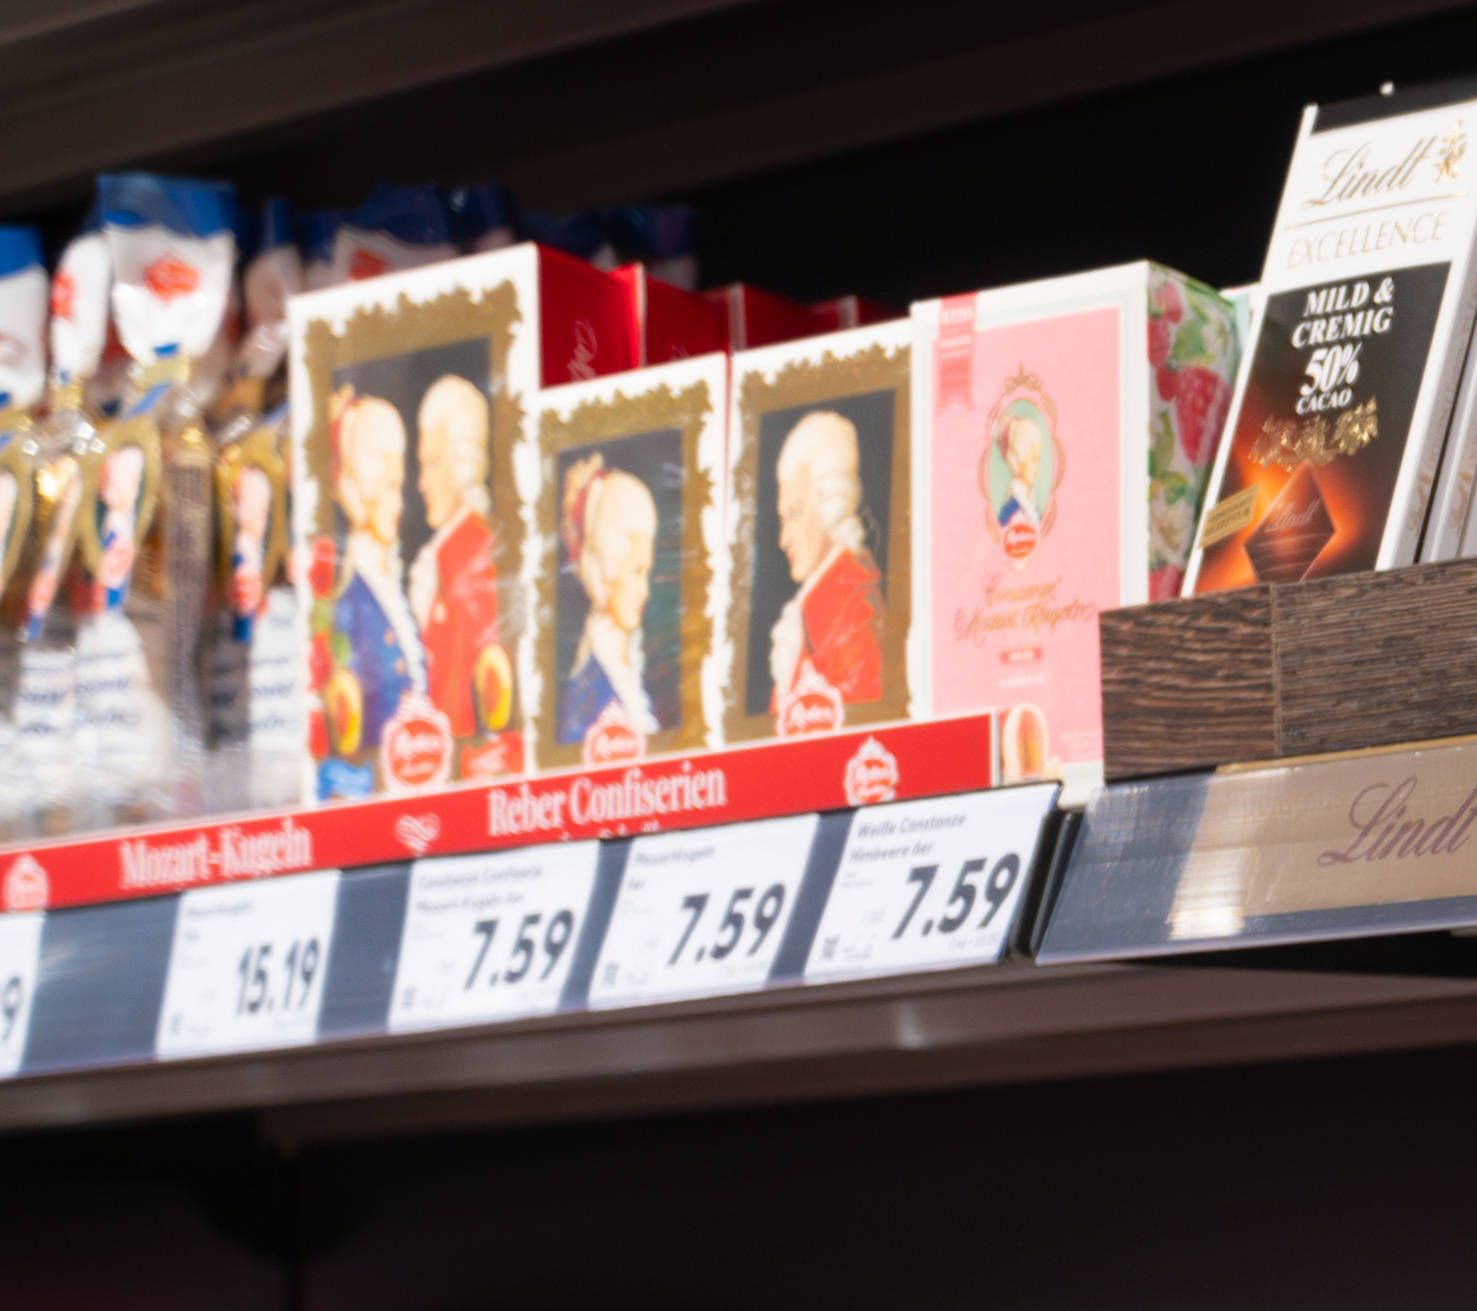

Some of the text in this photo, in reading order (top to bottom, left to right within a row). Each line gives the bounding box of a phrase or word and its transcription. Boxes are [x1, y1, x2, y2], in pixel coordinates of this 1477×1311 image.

[1285, 211, 1445, 270] EXCELLENCE
[1292, 308, 1393, 349] CREMIG
[1304, 277, 1394, 316] MILD &
[1301, 343, 1361, 397] 50%
[488, 762, 727, 837] Reber Confiserien
[120, 818, 313, 892] Mozart-Kugeln
[666, 883, 788, 968] 7.59
[889, 852, 1021, 941] 7.59
[234, 938, 323, 1019] 15.19
